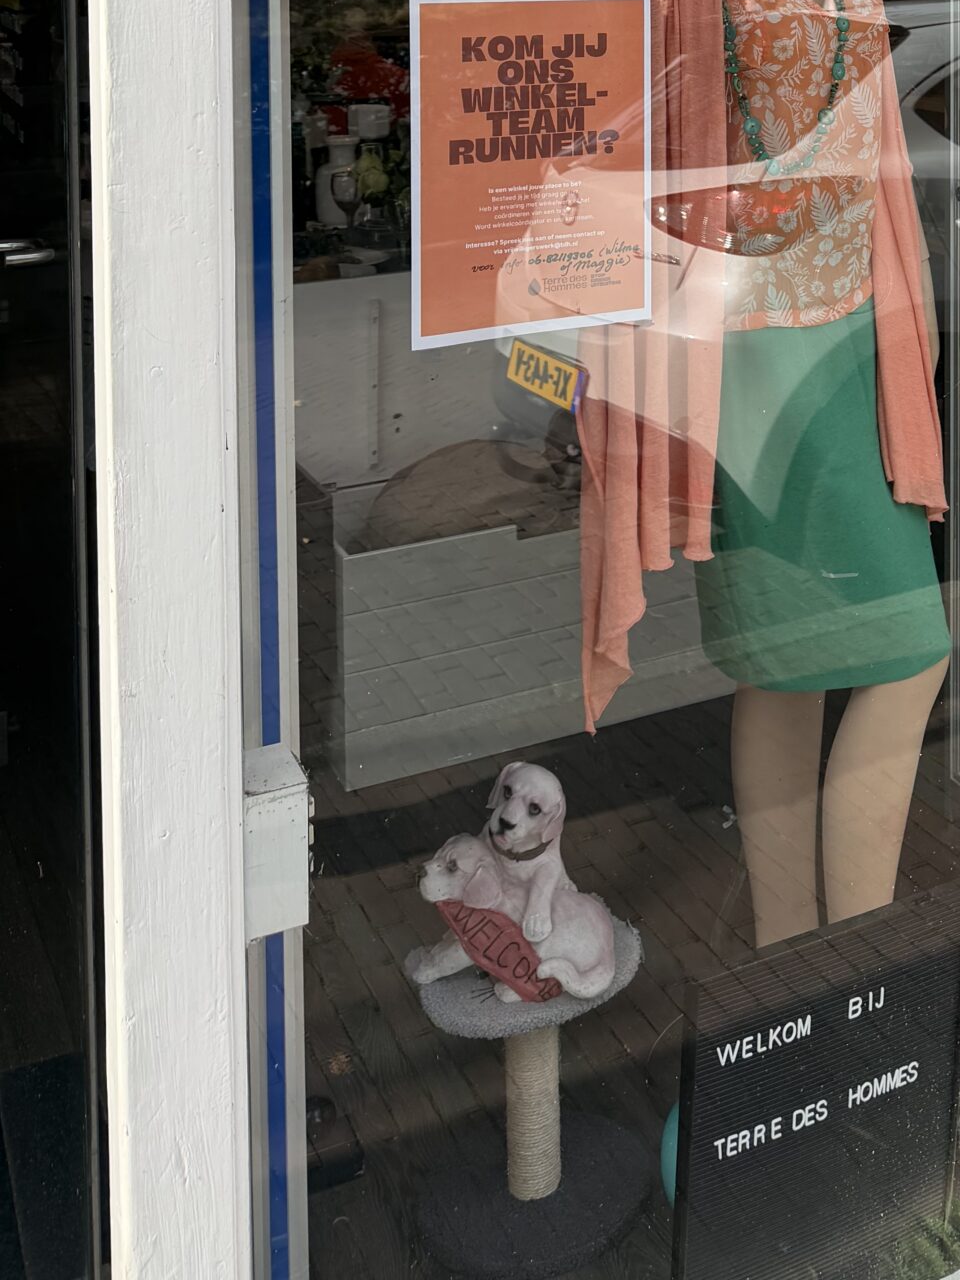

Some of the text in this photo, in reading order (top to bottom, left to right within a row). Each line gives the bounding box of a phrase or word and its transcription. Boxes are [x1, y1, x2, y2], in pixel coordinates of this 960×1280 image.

[461, 32, 608, 63] KOM JIJ
[497, 58, 575, 86] ONS
[461, 82, 609, 114] WINKEL-
[486, 106, 586, 138] TEAM
[449, 129, 621, 166] RUNNEN?
[716, 986, 886, 1067] WELKOM BIJ
[713, 1061, 919, 1161] TERRE DES HOMMES
